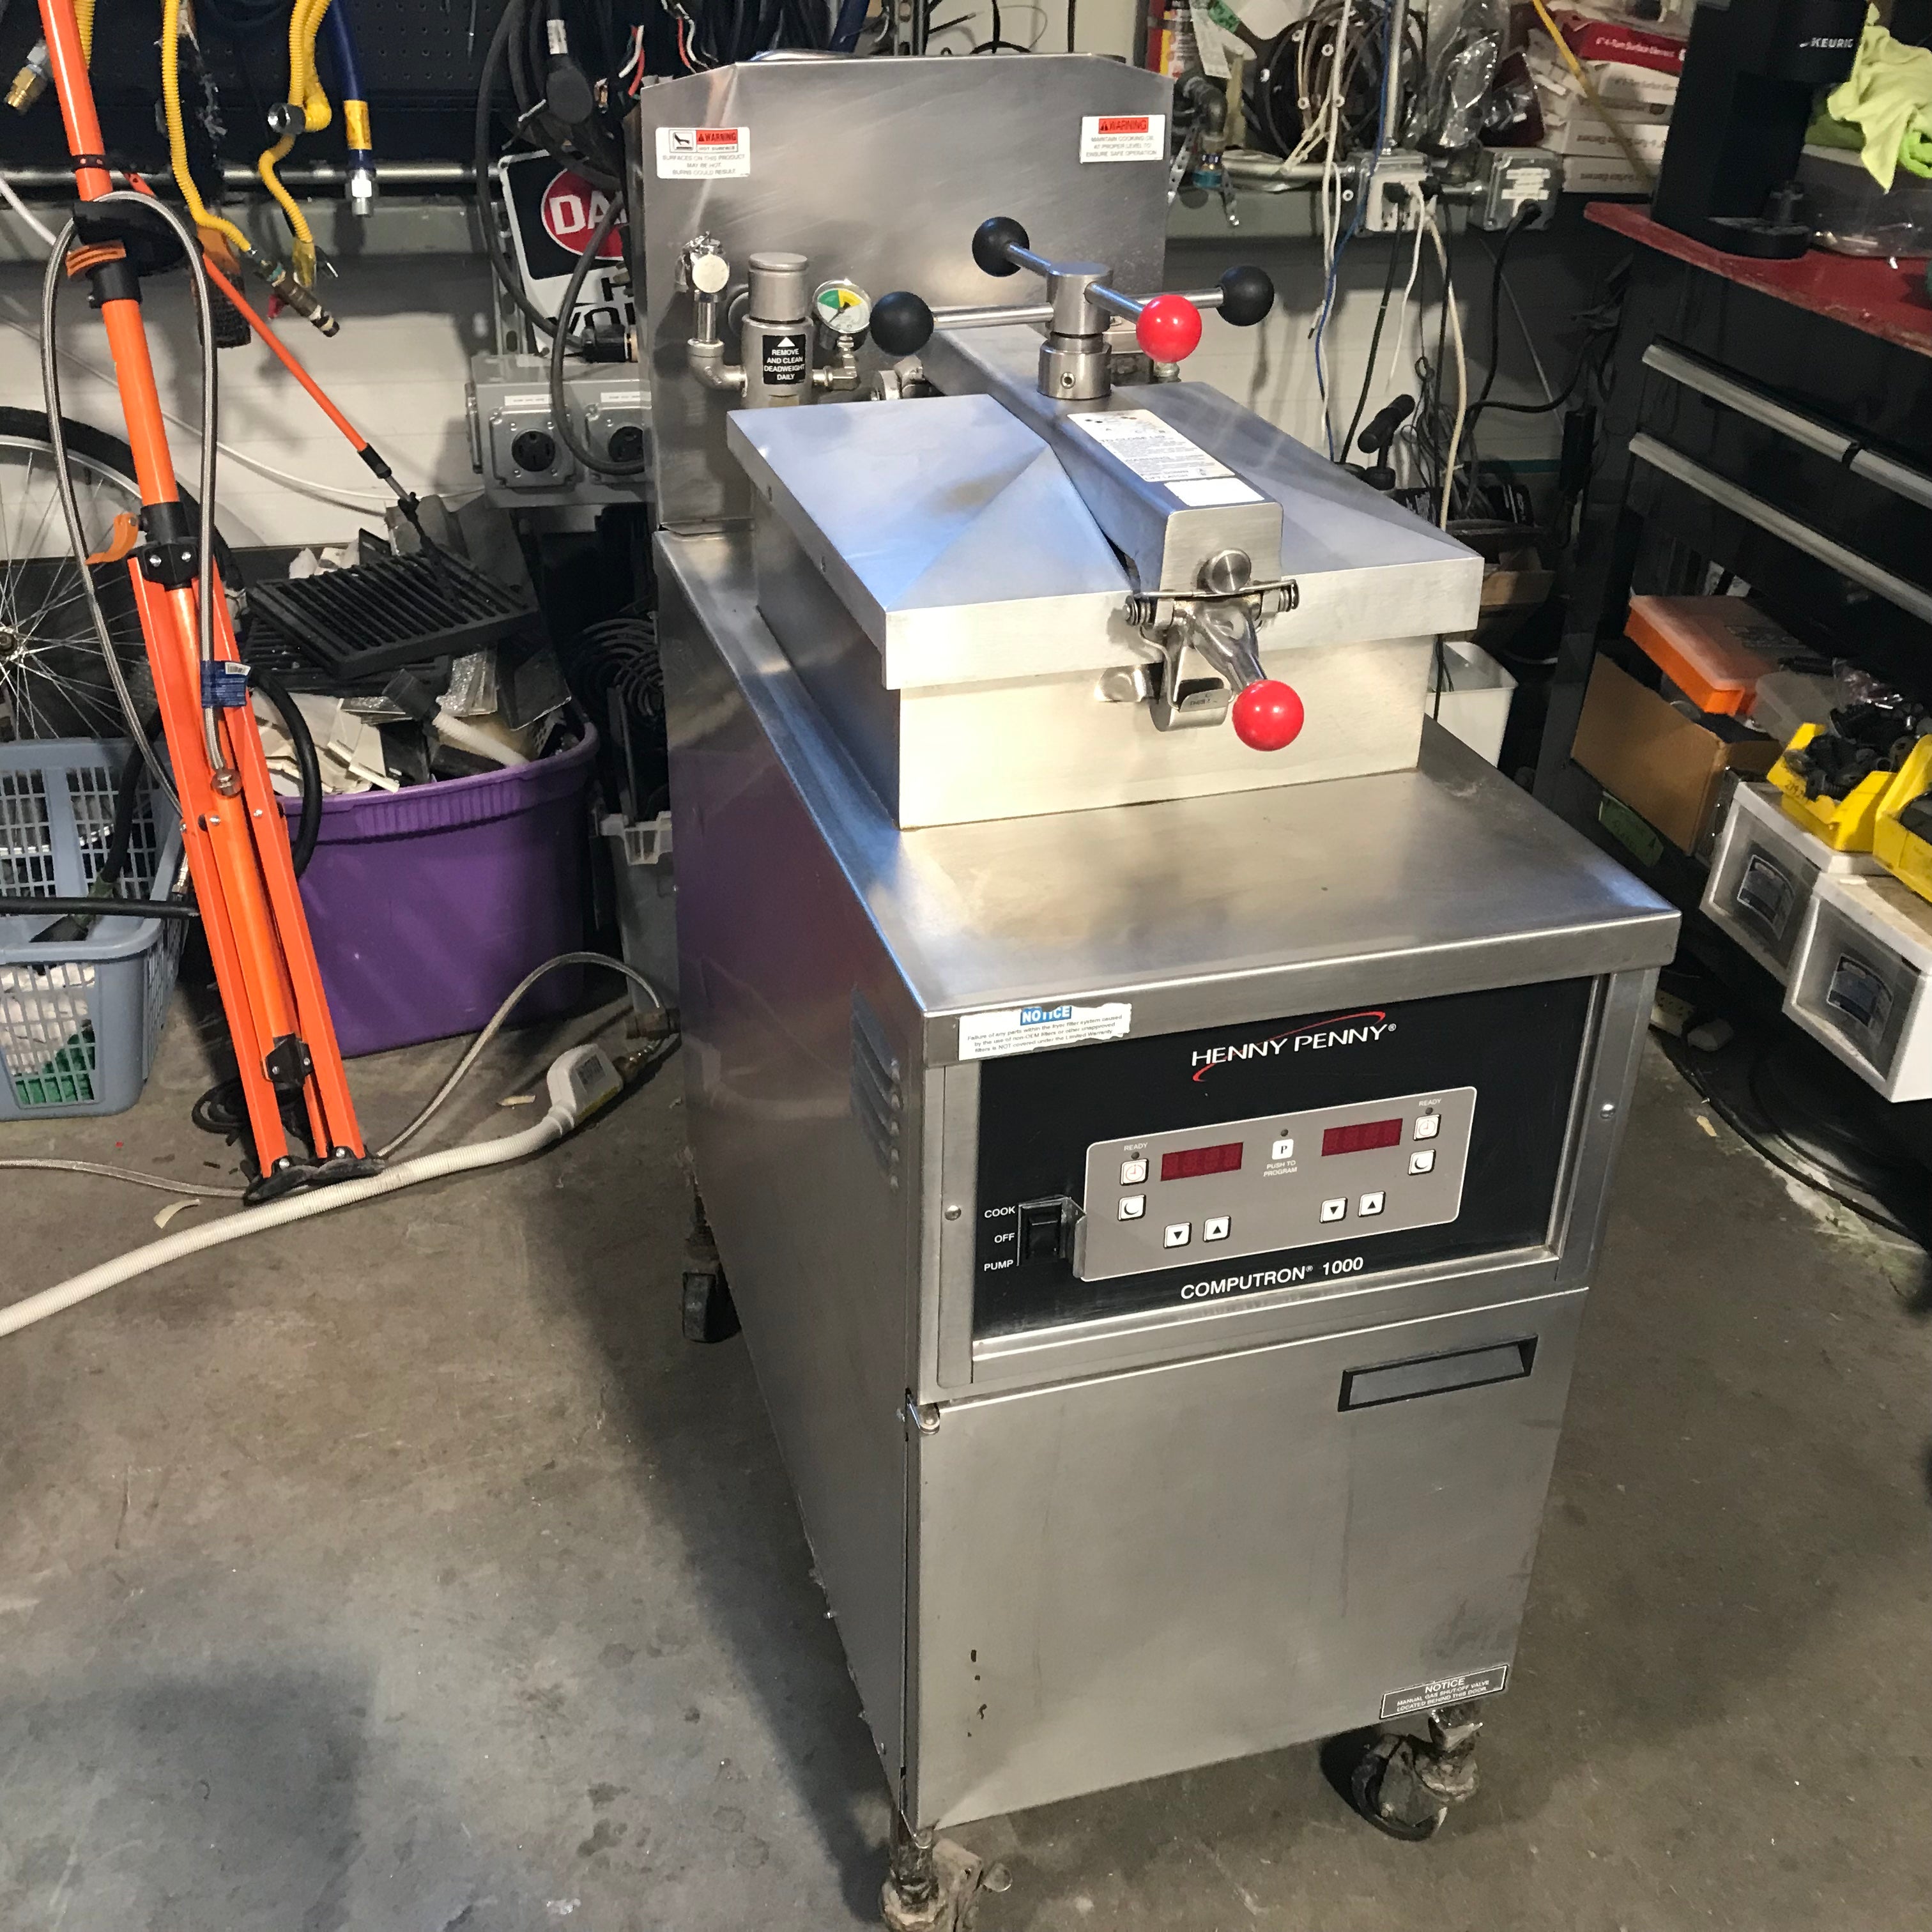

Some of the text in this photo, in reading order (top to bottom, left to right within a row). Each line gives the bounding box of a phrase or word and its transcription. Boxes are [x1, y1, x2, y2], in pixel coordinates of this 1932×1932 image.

[1811, 38, 1853, 48] KEURIG
[1110, 119, 1147, 131] WARNING
[704, 132, 737, 141] WARNING
[783, 356, 803, 364] CLEAN
[763, 364, 805, 372] DEADWEIGHT
[1013, 1032, 1039, 1041] non-OEM
[1081, 1022, 1116, 1031] unapproved
[1191, 1038, 1289, 1067] HENNY
[1418, 1098, 1442, 1107] READY
[1124, 1142, 1148, 1151] READY
[1280, 1145, 1288, 1154] P
[1266, 1162, 1285, 1170] PUSH
[1263, 1167, 1298, 1177] PROGRAM
[984, 1206, 1016, 1218] COOK
[994, 1232, 1015, 1243] OFF
[984, 1259, 1014, 1271] PUMP
[1322, 1257, 1364, 1275] 1000
[1425, 1677, 1466, 1694] NOTICE
[1397, 1696, 1423, 1706] MANUAL
[1425, 1692, 1438, 1700] GAS
[1471, 1680, 1490, 1689] VALVE
[1397, 1701, 1426, 1712] LOCATED
[1427, 1695, 1451, 1705] BEHIND
[1468, 1686, 1487, 1695] DOOR
